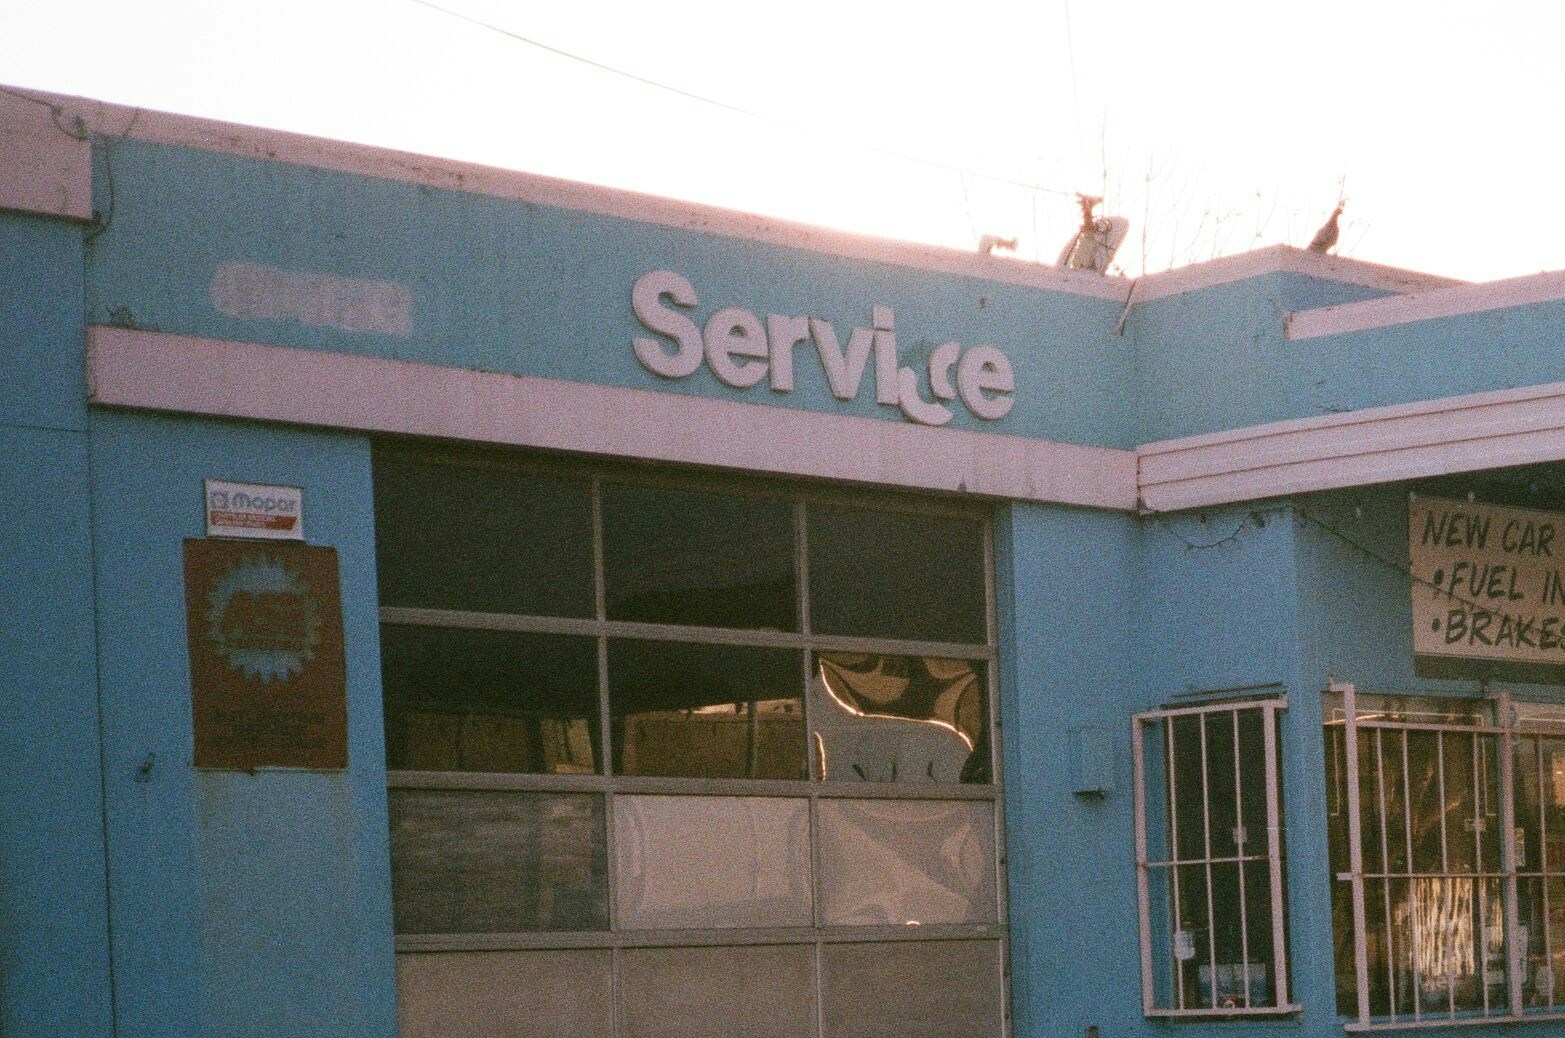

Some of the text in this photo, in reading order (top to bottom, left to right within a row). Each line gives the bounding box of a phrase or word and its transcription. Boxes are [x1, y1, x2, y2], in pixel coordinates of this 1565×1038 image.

[1421, 508, 1490, 550] NEW
[1502, 518, 1555, 558] CAR
[1446, 561, 1525, 602] FUEL
